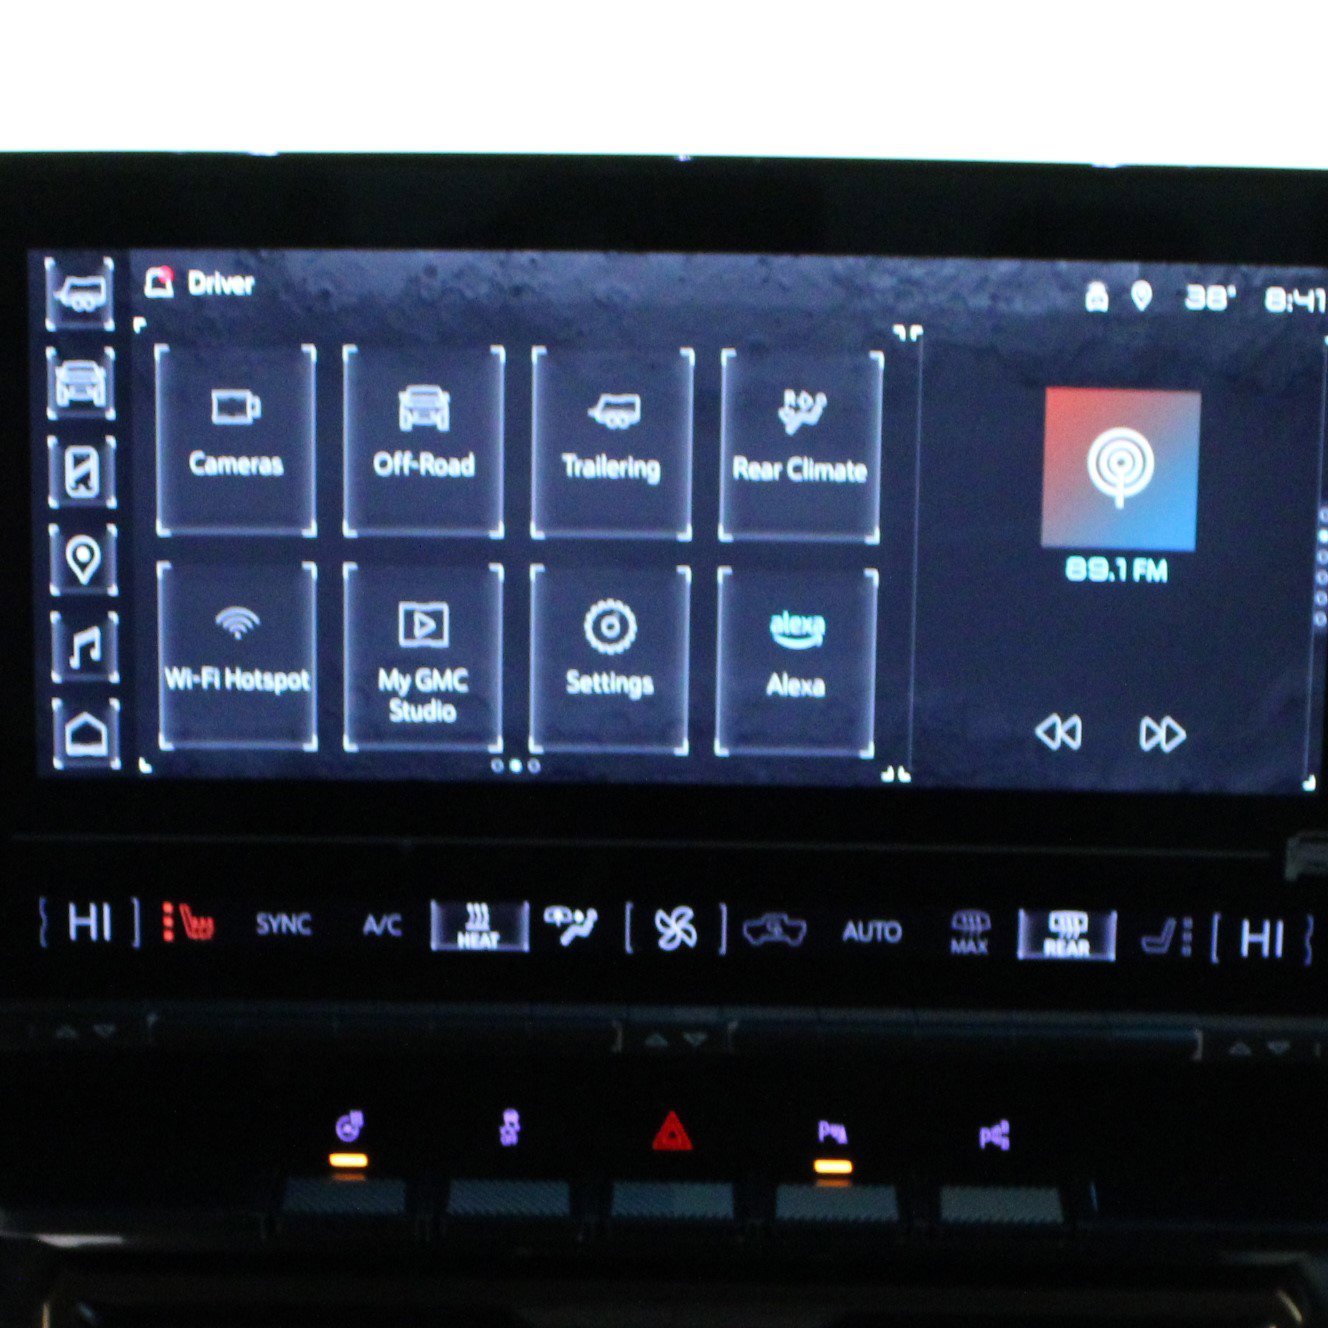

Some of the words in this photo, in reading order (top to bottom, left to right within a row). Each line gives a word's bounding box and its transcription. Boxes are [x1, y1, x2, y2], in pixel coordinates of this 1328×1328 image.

[187, 271, 254, 296] Driver
[1265, 286, 1326, 314] 8:41
[189, 451, 284, 477] Cameras
[373, 451, 475, 478] Off-Road
[562, 453, 661, 485] Trailering
[733, 456, 782, 481] Rear
[787, 456, 868, 483] Climate
[1066, 556, 1128, 582] 89.1
[1133, 557, 1168, 584] FM
[770, 612, 825, 635] alexa
[165, 666, 221, 691] Wi-Fi
[224, 666, 311, 697] Hotspot
[378, 669, 415, 696] My
[417, 669, 468, 694] GMC
[566, 670, 653, 702] Settings
[766, 673, 826, 697] Alexa
[389, 699, 456, 725] Studio
[69, 902, 111, 942] HI
[256, 913, 312, 936] SYNC
[363, 914, 402, 937] A/C
[843, 919, 902, 943] AUTO
[457, 931, 499, 950] HEAT
[950, 937, 988, 955] MAX
[1043, 937, 1090, 957] REAR
[1241, 918, 1284, 958] HI
